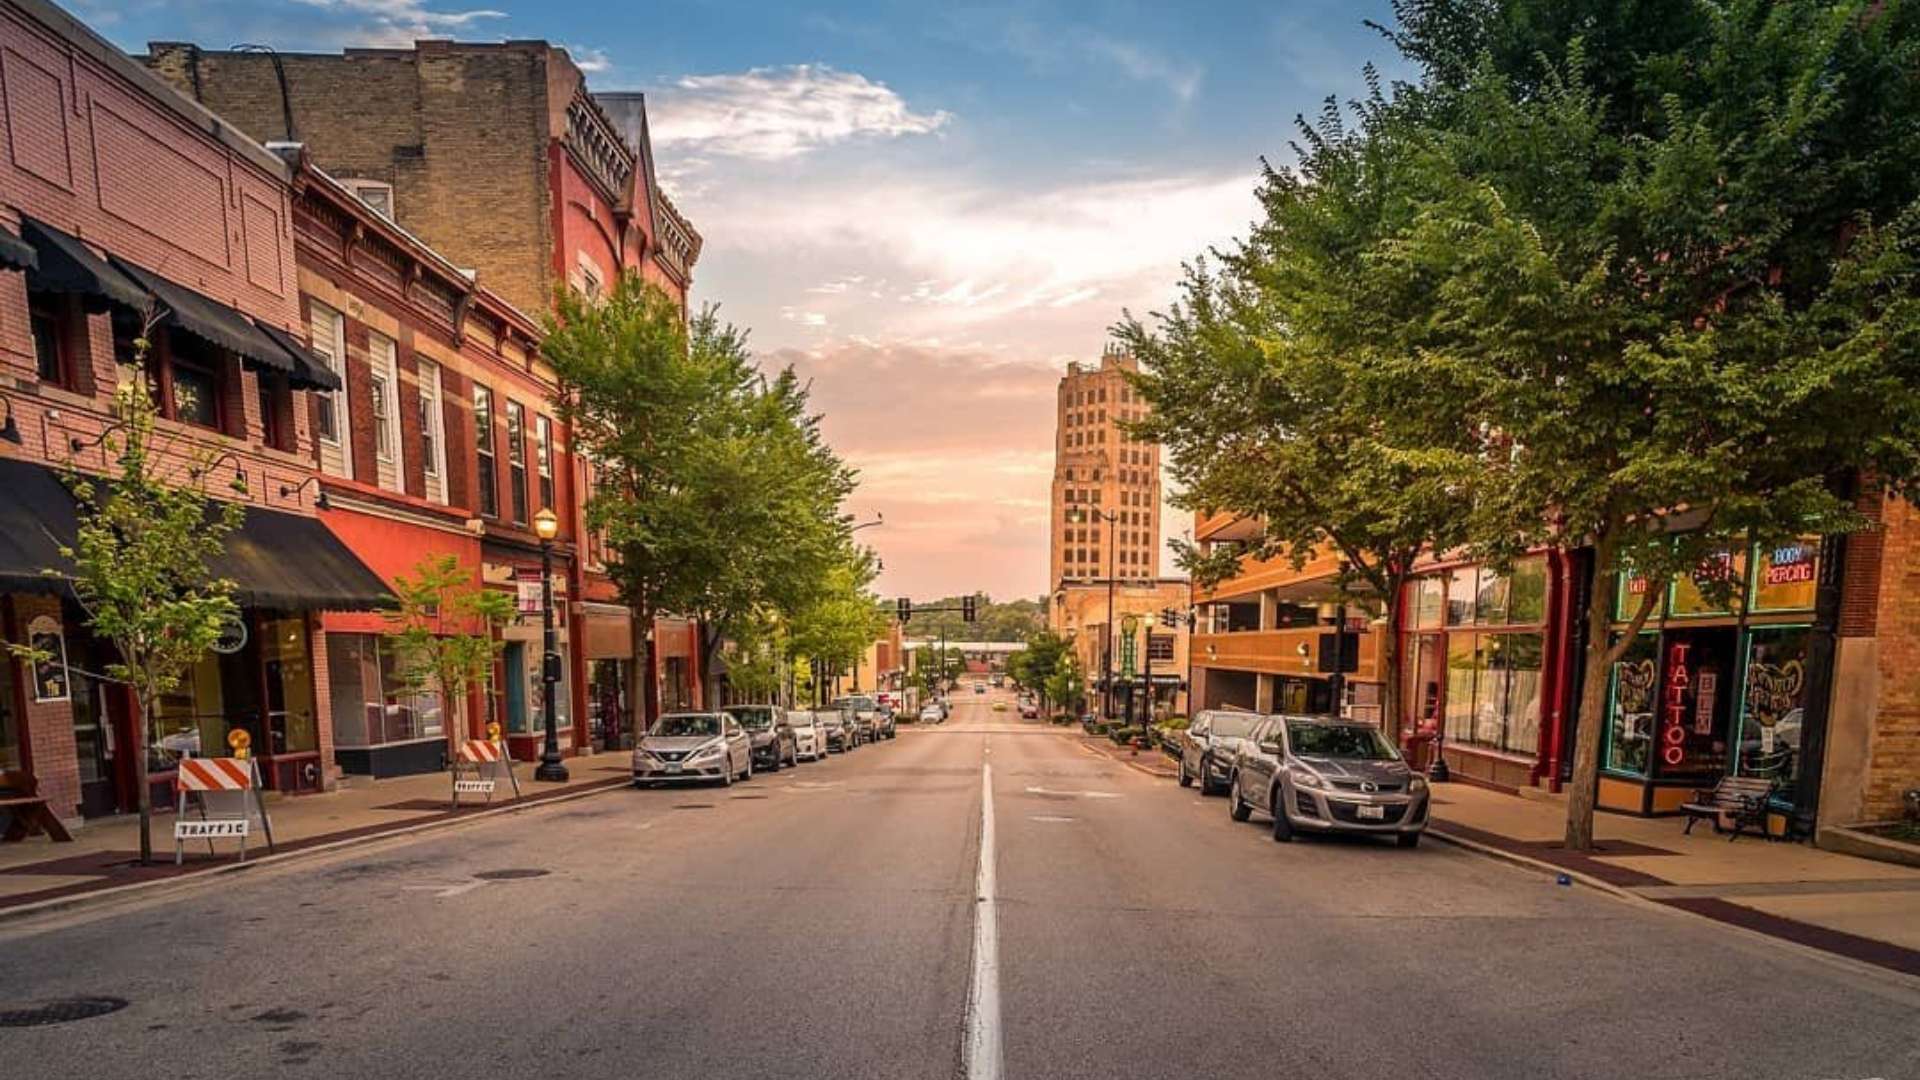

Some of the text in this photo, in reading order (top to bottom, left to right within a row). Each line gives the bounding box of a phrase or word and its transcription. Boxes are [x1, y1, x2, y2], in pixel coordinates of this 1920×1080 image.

[1774, 547, 1802, 565] BODY
[1767, 563, 1812, 583] PIERCING
[1665, 644, 1691, 764] TATTOO
[179, 823, 244, 836] TRAFFIC
